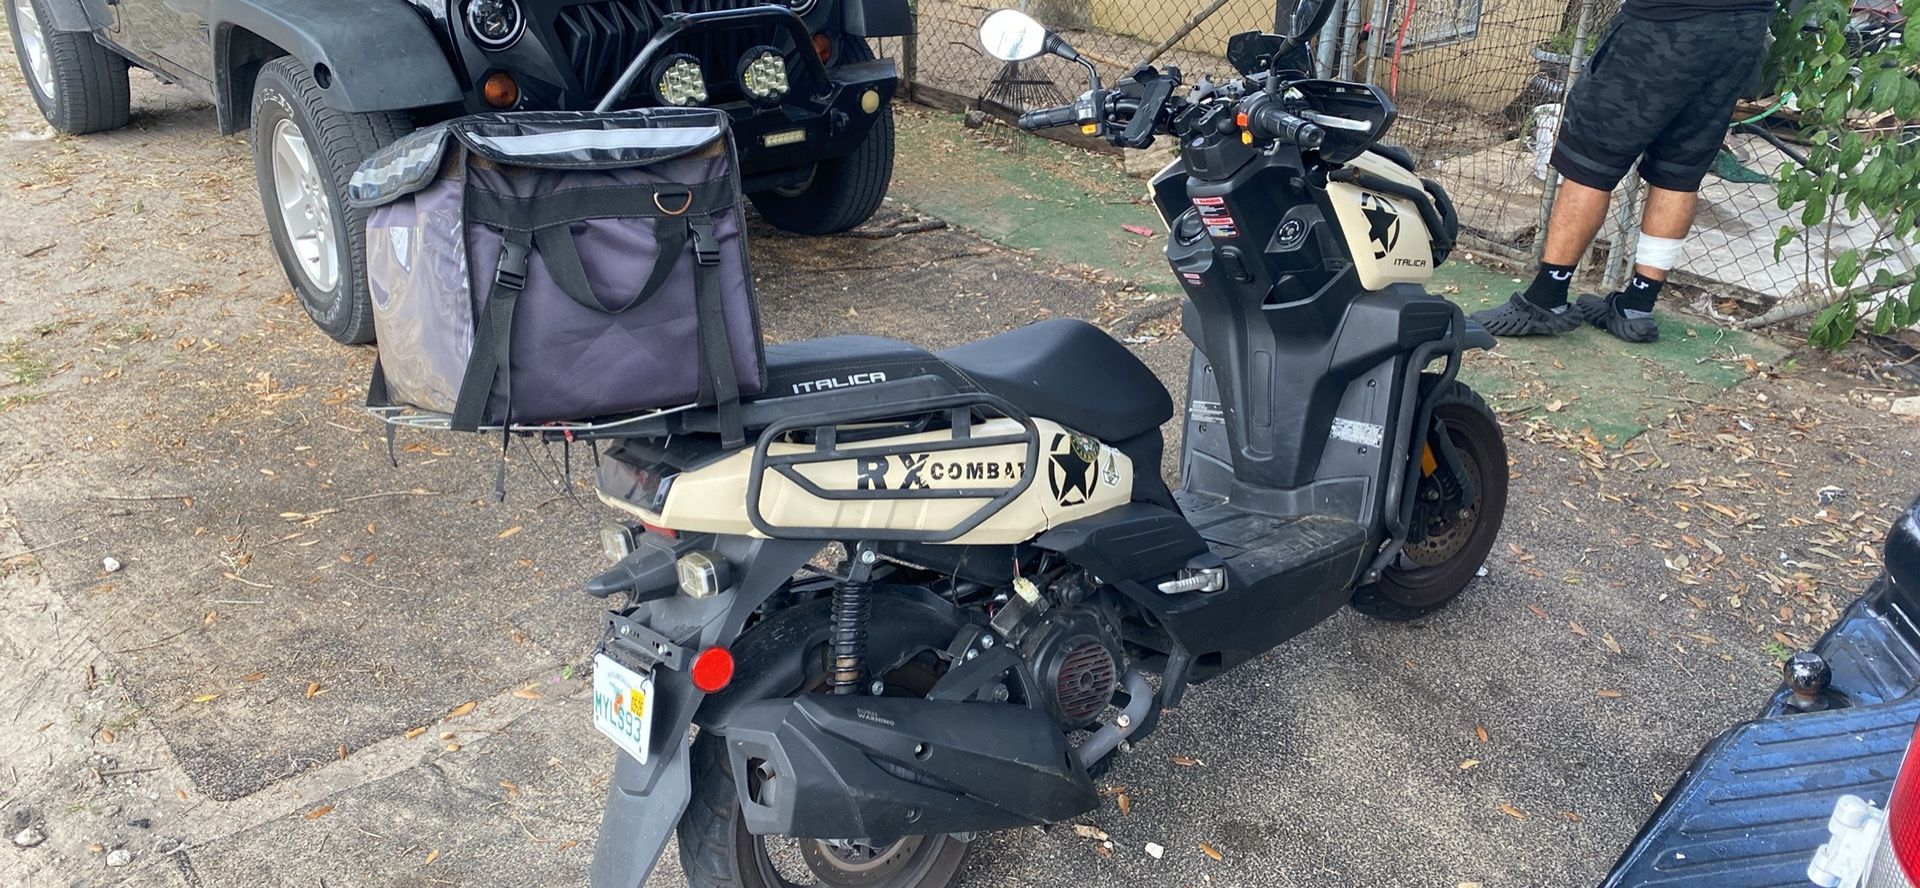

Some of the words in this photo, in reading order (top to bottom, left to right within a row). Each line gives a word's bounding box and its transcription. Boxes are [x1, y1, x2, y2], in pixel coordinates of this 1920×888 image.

[1393, 258, 1426, 267] ITALICA
[792, 372, 886, 394] ITALICA
[856, 453, 930, 490] RX
[595, 688, 642, 743] MYLS93
